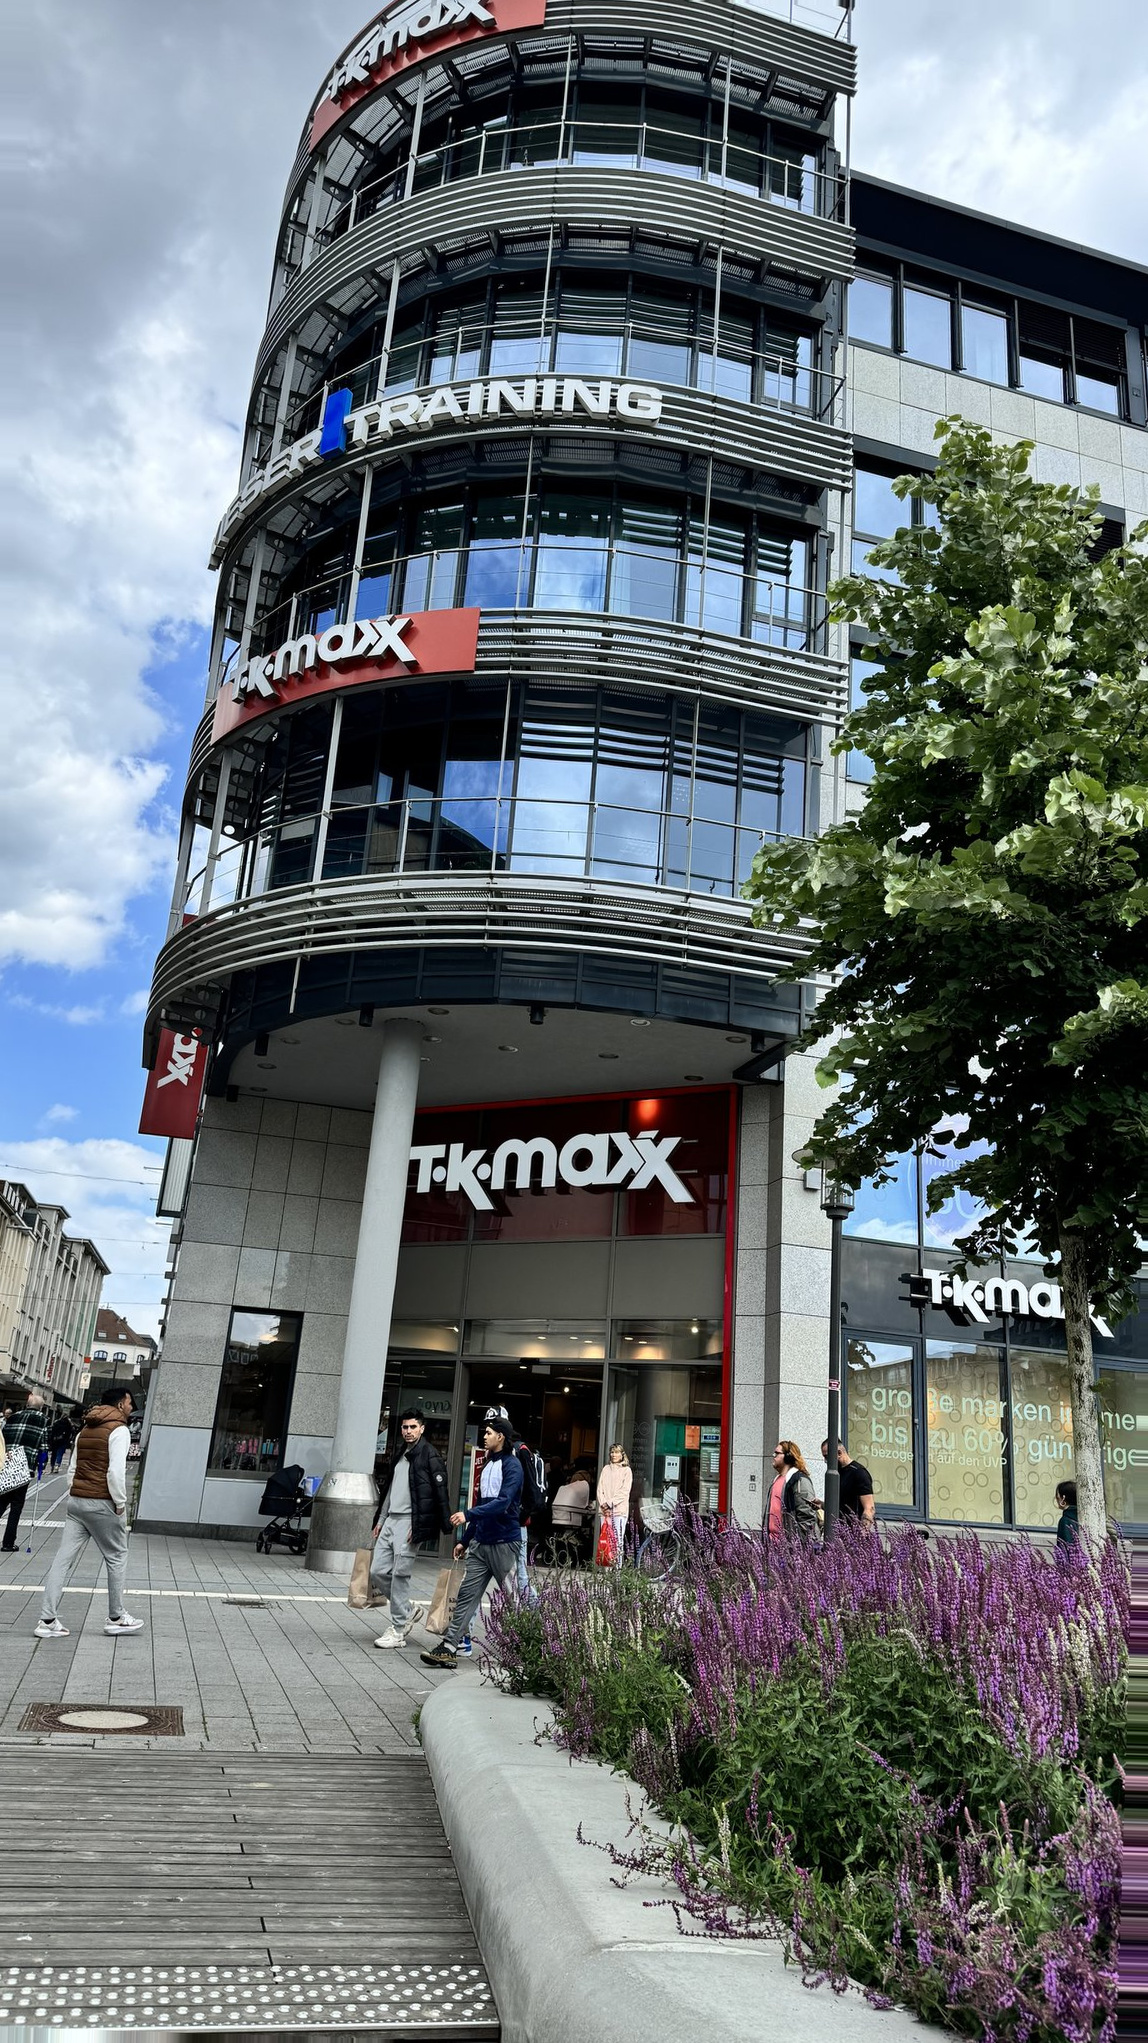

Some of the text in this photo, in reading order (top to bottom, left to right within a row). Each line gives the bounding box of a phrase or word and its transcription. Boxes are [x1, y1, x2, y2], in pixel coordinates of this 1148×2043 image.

[343, 378, 662, 448] TRAINING
[961, 1396, 1052, 1424] marken
[871, 1417, 909, 1445] bis
[928, 1429, 956, 1450] zu
[964, 1427, 1019, 1456] 60%
[937, 1452, 956, 1465] auf
[959, 1453, 980, 1467] den
[983, 1456, 1008, 1469] UVP
